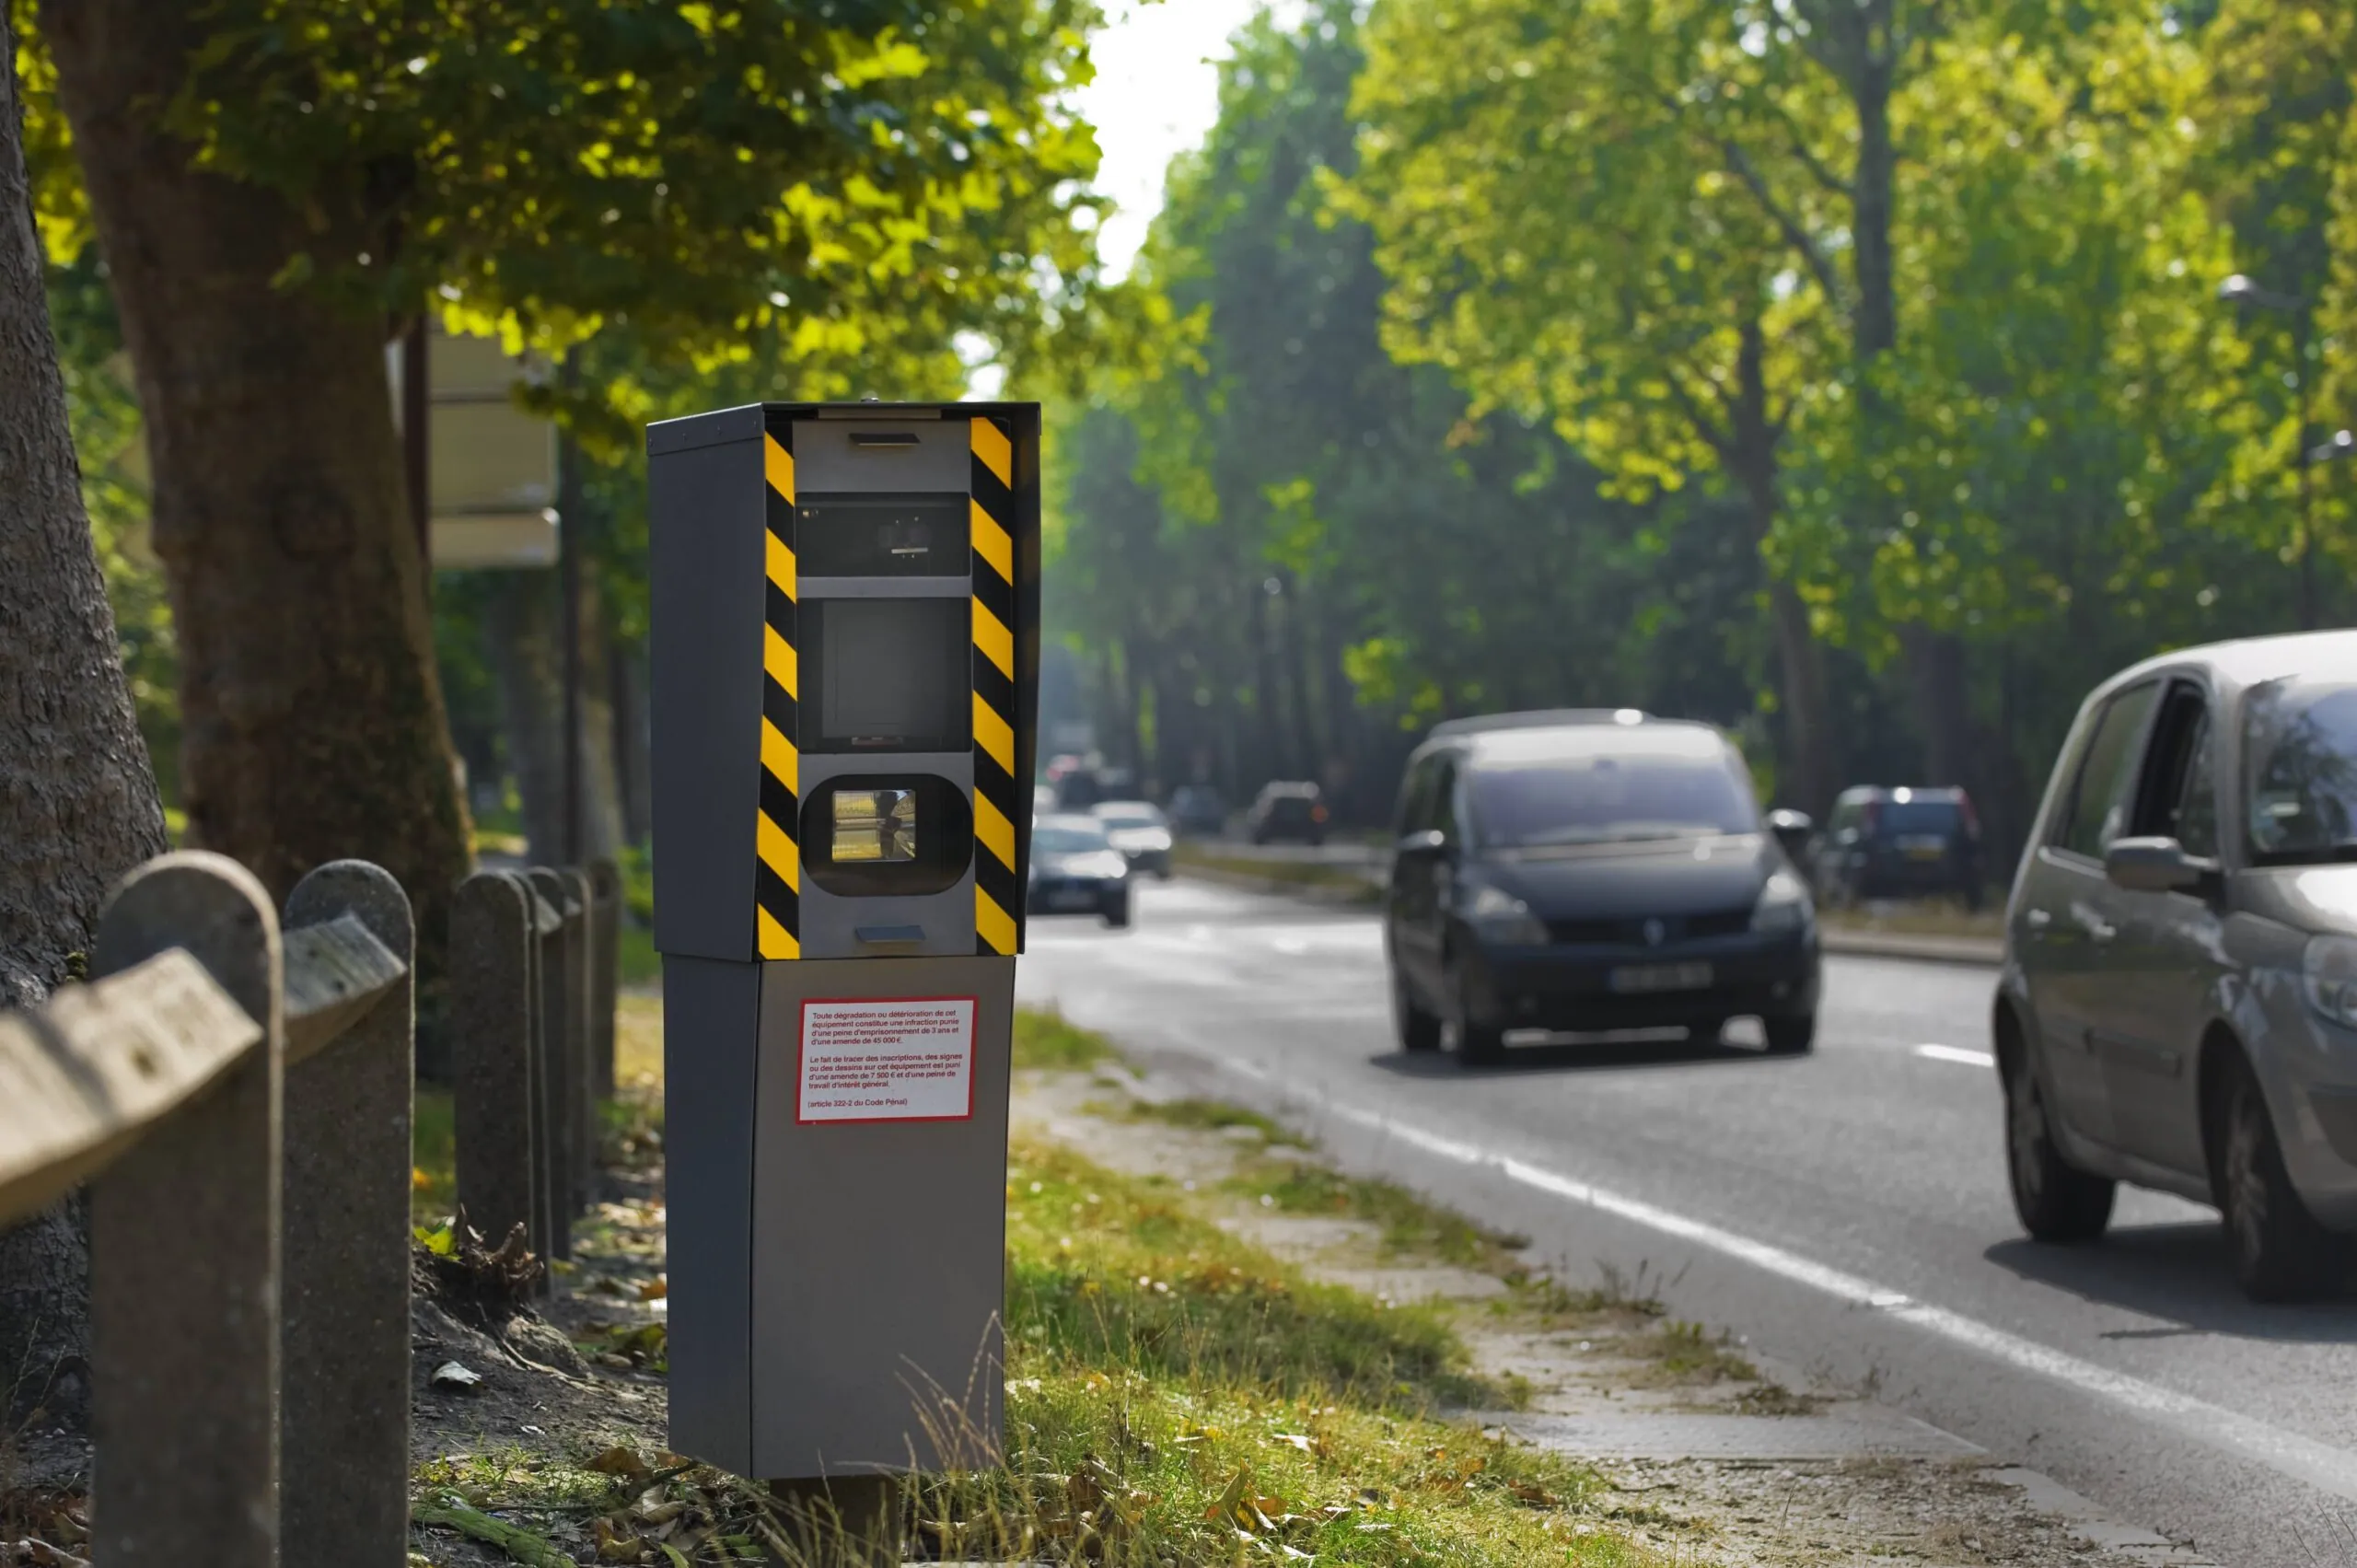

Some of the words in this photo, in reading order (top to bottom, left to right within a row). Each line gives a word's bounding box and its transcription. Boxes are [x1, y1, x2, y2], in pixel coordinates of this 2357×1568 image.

[834, 1012, 876, 1020] dégradation
[939, 1018, 958, 1027] punie
[854, 1028, 919, 1036] d'emprisonnement
[808, 1099, 831, 1108] (article
[886, 1098, 908, 1106] Pénal)
